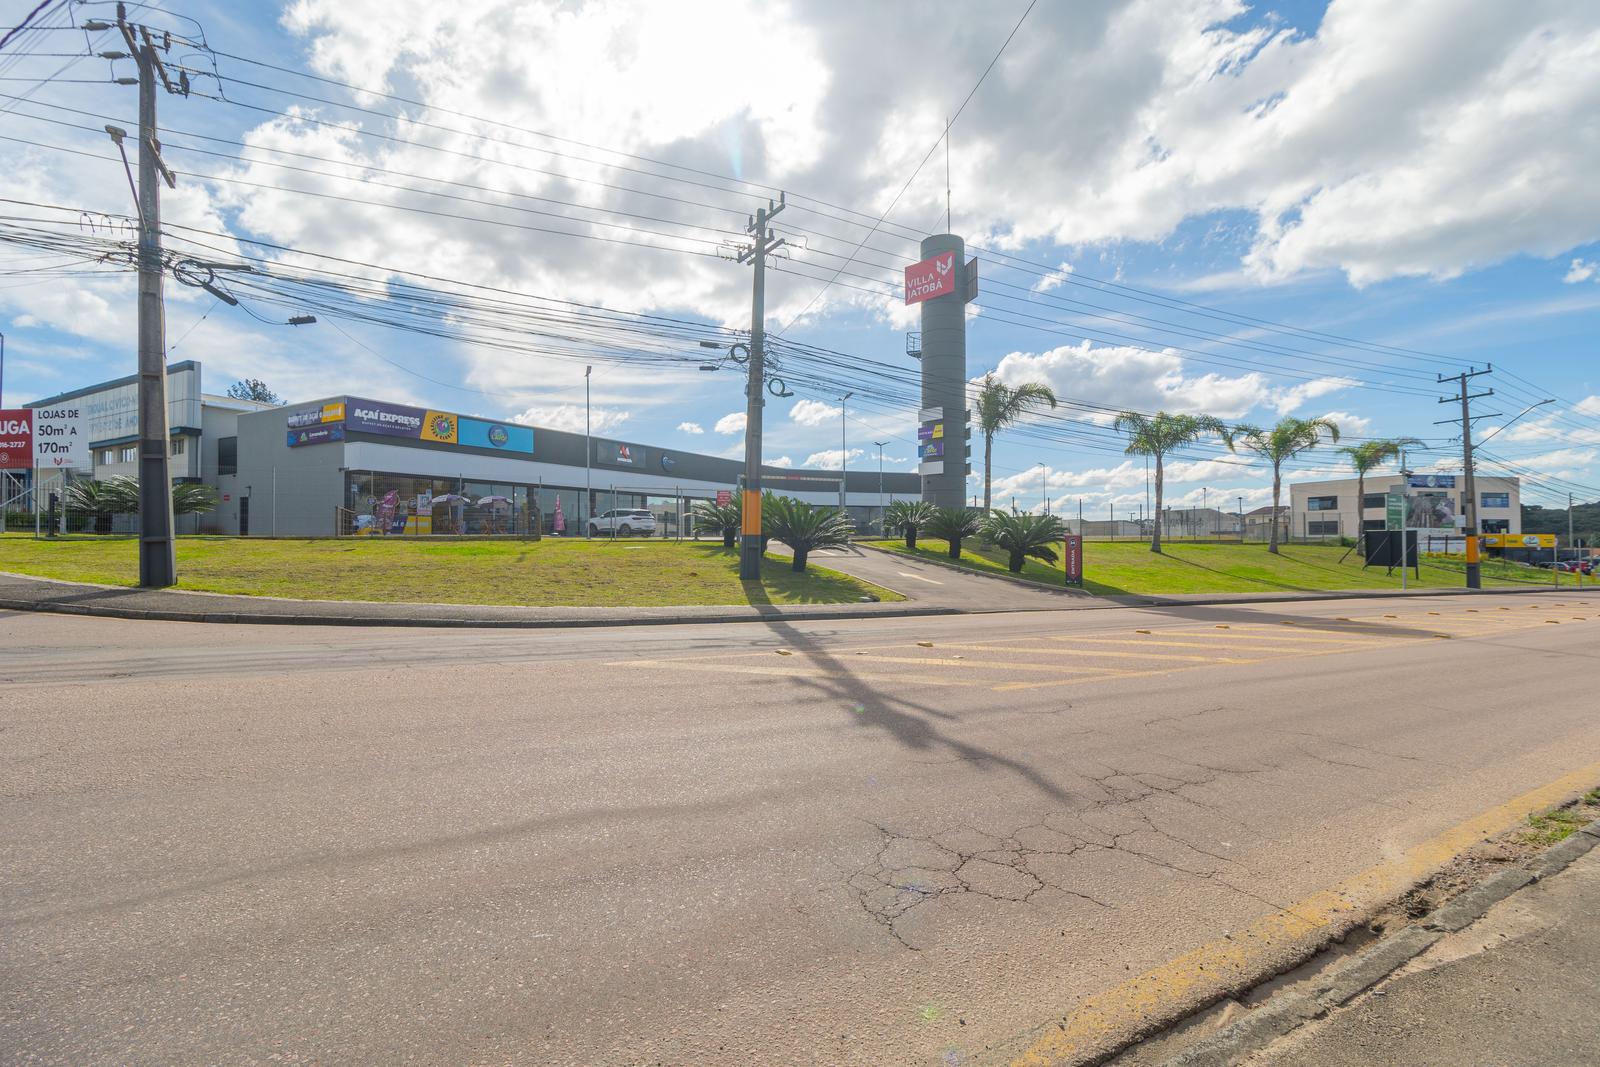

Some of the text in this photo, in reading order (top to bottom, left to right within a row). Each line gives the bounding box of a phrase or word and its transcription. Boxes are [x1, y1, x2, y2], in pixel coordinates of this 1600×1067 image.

[907, 273, 934, 288] VILLA
[907, 279, 943, 301] JATOBÁ
[37, 409, 79, 420] LOJAS DE
[353, 408, 379, 421] AÇAÍ
[379, 411, 421, 426] EXPRESS
[70, 426, 77, 435] A
